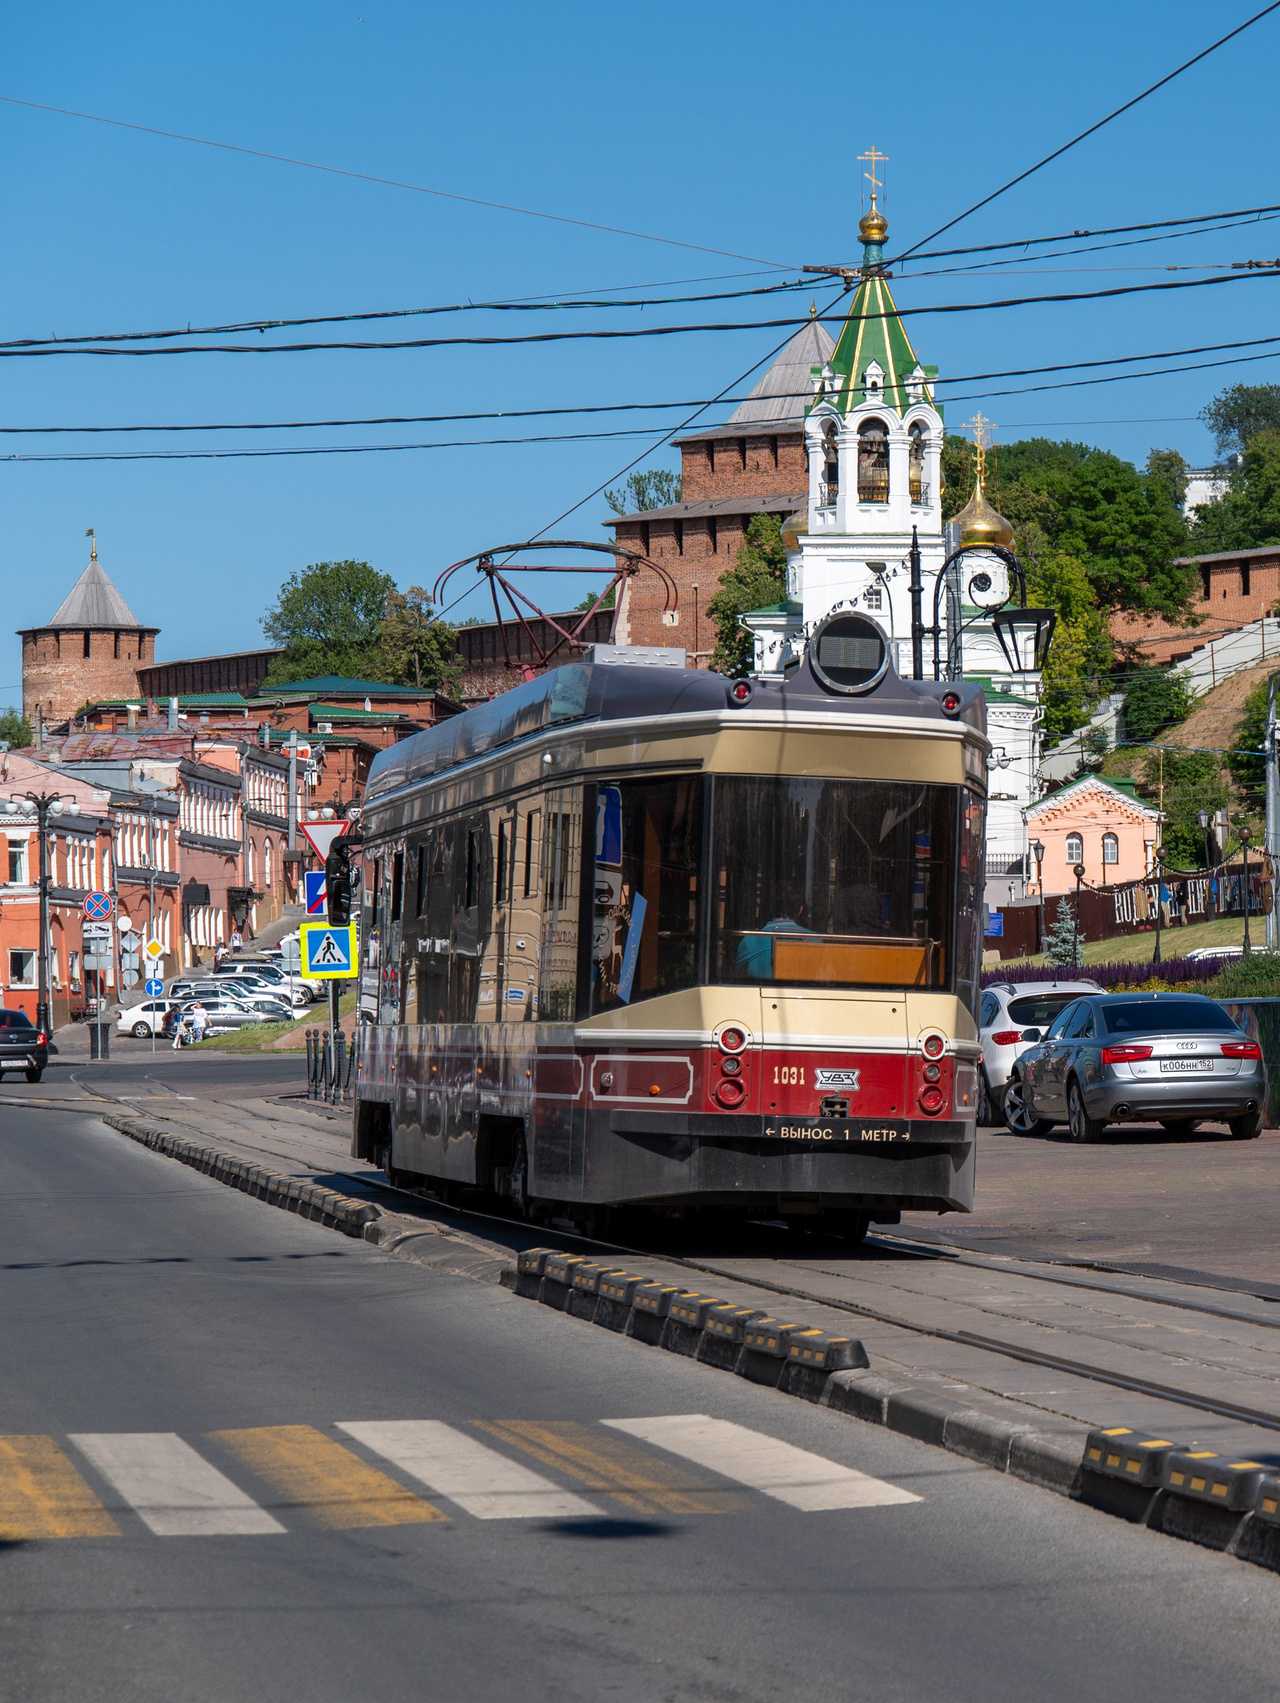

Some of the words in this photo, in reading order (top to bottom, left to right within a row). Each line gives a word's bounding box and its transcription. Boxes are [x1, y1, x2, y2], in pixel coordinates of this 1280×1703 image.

[1199, 1059, 1212, 1068] 152
[773, 1066, 805, 1085] 1031
[780, 1127, 833, 1140] ВЫНОС
[844, 1129, 850, 1141] 1
[861, 1130, 897, 1141] МЕТР
